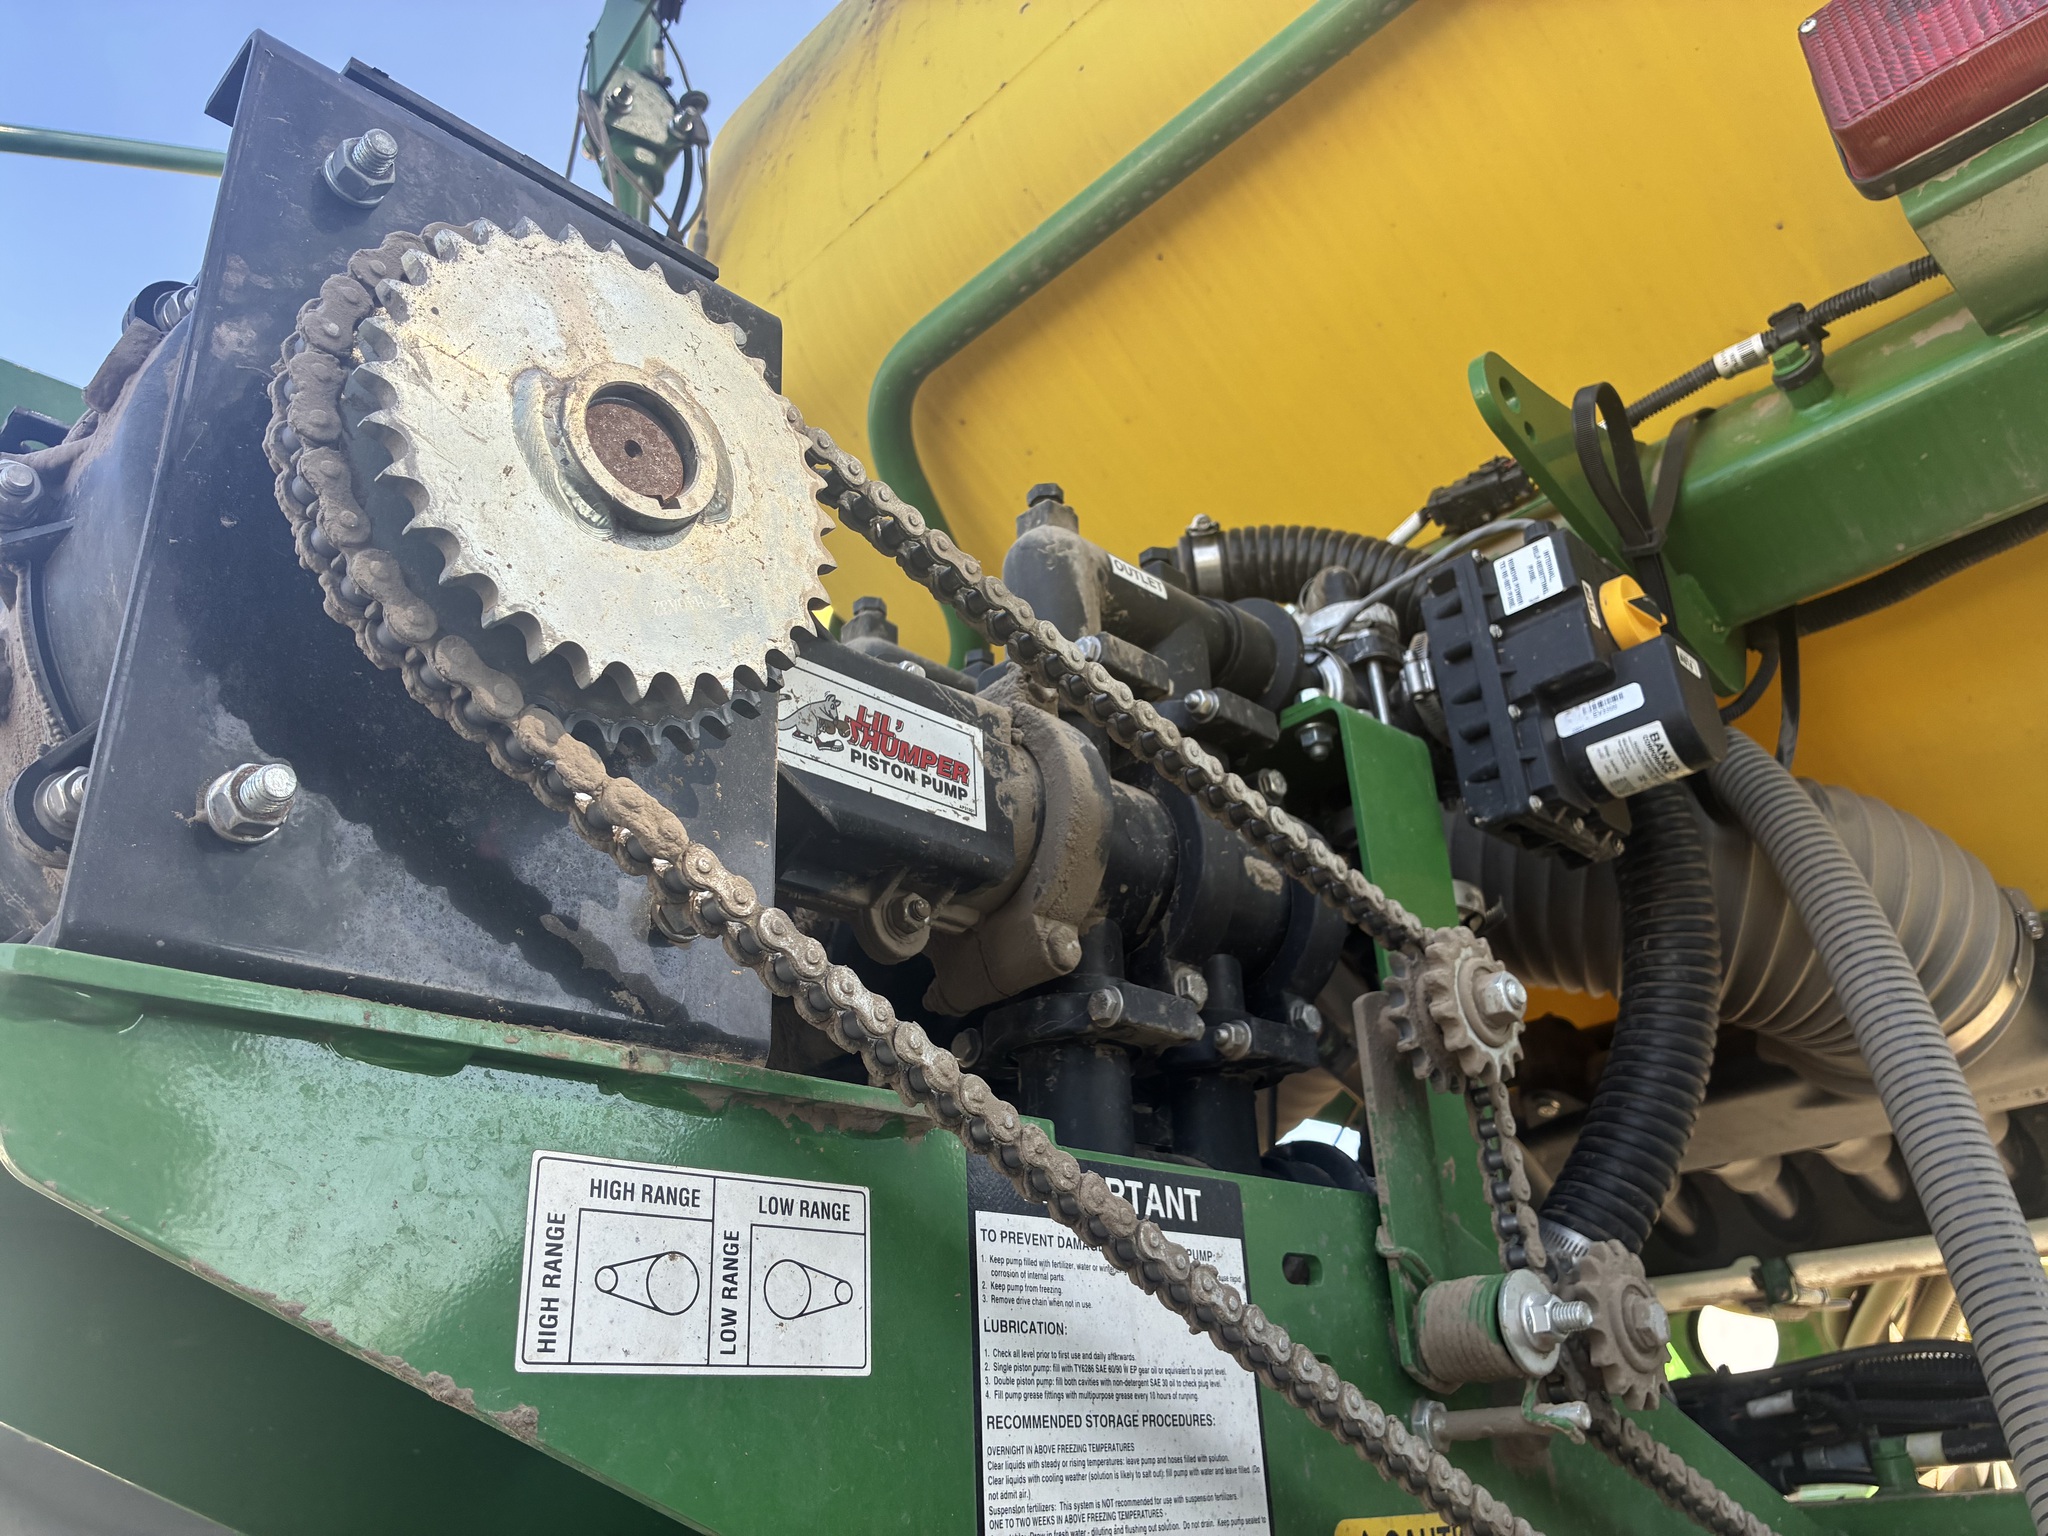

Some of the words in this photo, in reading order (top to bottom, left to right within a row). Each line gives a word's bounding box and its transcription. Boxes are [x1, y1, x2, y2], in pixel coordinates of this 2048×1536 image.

[1114, 559, 1162, 592] OUTLET
[857, 705, 904, 738] LIL'
[844, 715, 970, 787] THUMPER
[1650, 732, 1679, 772] BANJO
[851, 748, 915, 784] PISTON
[922, 774, 968, 800] PUMP
[590, 1178, 635, 1202] HIGH
[641, 1184, 701, 1208] RANGE
[759, 1196, 794, 1216] LOW
[799, 1200, 850, 1222] RANGE
[542, 1213, 566, 1288] RANGE
[980, 1229, 996, 1242] TO
[1000, 1231, 1054, 1247] PREVENT
[1187, 1249, 1216, 1261] PUMP:
[722, 1230, 739, 1300] RANGE
[990, 1255, 1005, 1266] Keep
[1006, 1257, 1022, 1267] pump
[1024, 1257, 1037, 1266] filled
[1039, 1259, 1051, 1268] with
[1077, 1263, 1091, 1271] water
[991, 1269, 1018, 1279] corrosion
[1020, 1270, 1026, 1279] of
[1028, 1270, 1048, 1280] internal
[1050, 1273, 1065, 1282] parts.
[982, 1281, 987, 1289] 2.
[990, 1282, 1006, 1292] Keep
[1007, 1284, 1023, 1293] pump
[1024, 1283, 1038, 1292] from
[1039, 1285, 1063, 1296] freezing.
[982, 1294, 988, 1303] 3.
[991, 1295, 1014, 1304] Remove
[1016, 1296, 1030, 1305] drive
[1032, 1297, 1048, 1306] chain
[1048, 1298, 1064, 1307] when
[1064, 1300, 1074, 1308] not
[537, 1297, 559, 1353] HIGH
[720, 1309, 738, 1355] LOW
[984, 1319, 1068, 1335] LUBRICATION:
[984, 1349, 990, 1358] 1.
[993, 1348, 1012, 1358] Check
[1021, 1349, 1035, 1358] level
[1037, 1350, 1050, 1360] prior
[1058, 1350, 1069, 1359] first
[1082, 1352, 1092, 1360] and
[1093, 1352, 1106, 1362] daily
[985, 1363, 990, 1371] 2.
[993, 1362, 1012, 1373] Single
[1013, 1364, 1032, 1373] piston
[1034, 1365, 1052, 1374] pump:
[1061, 1364, 1073, 1372] with
[1096, 1364, 1107, 1373] SAE
[1130, 1365, 1137, 1374] EP
[1138, 1367, 1150, 1376] gear
[1165, 1366, 1190, 1376] equivalent
[1204, 1367, 1214, 1376] port
[985, 1377, 990, 1385] 3.
[994, 1377, 1015, 1386] Double
[1016, 1377, 1035, 1387] piston
[1036, 1378, 1055, 1387] pump:
[1055, 1377, 1063, 1386] fill
[1064, 1377, 1077, 1386] both
[1078, 1377, 1099, 1386] cavities
[1100, 1378, 1112, 1386] with
[1113, 1378, 1149, 1388] non-detergent
[1150, 1378, 1161, 1387] SAE
[1162, 1378, 1168, 1387] 30
[1183, 1379, 1197, 1388] check
[1198, 1380, 1208, 1389] plug
[985, 1390, 991, 1399] 4.
[994, 1390, 1003, 1399] Fill
[1005, 1392, 1022, 1401] pump
[1023, 1392, 1043, 1401] grease
[1044, 1390, 1064, 1401] fittings
[1066, 1391, 1077, 1399] with
[1078, 1391, 1114, 1401] multipurpose
[1115, 1392, 1133, 1401] grease
[1134, 1393, 1148, 1401] every
[1157, 1391, 1172, 1400] hours
[987, 1415, 1082, 1430] RECOMMENDED
[1086, 1414, 1139, 1429] STORAGE
[1142, 1414, 1216, 1427] PROCEDURES:
[987, 1445, 1024, 1456] OVERNIGHT
[1026, 1445, 1033, 1454] IN
[1034, 1445, 1055, 1454] ABOVE
[1057, 1444, 1087, 1454] FREEZING
[1088, 1442, 1135, 1453] TEMPERATURES
[987, 1461, 1004, 1471] Clear
[1005, 1460, 1025, 1471] liquids
[1027, 1459, 1040, 1469] with
[1041, 1459, 1060, 1470] steady
[1069, 1458, 1086, 1469] rising
[1087, 1457, 1124, 1468] temperatures:
[1125, 1456, 1140, 1465] leave
[1141, 1457, 1155, 1466] pump
[1157, 1456, 1167, 1464] and
[1168, 1455, 1183, 1463] hoses
[1184, 1455, 1196, 1463] filled
[1208, 1454, 1229, 1463] solution.
[988, 1476, 1004, 1485] Clear
[1005, 1475, 1026, 1486] liquids
[1028, 1474, 1040, 1483] with
[1042, 1473, 1064, 1484] cooling
[1065, 1472, 1087, 1481] weather
[1089, 1471, 1113, 1482] (solution
[1120, 1470, 1134, 1480] likely
[1142, 1470, 1151, 1478] salt
[1174, 1469, 1188, 1478] pump
[1189, 1468, 1199, 1476] with
[1215, 1467, 1224, 1475] and
[1225, 1466, 1238, 1474] leave
[988, 1491, 999, 1500] not
[1000, 1490, 1018, 1499] admit
[1019, 1489, 1031, 1500] air.)
[989, 1505, 1026, 1517] Suspension
[1027, 1504, 1057, 1513] fertilizers:
[1060, 1502, 1072, 1510] This
[1074, 1501, 1094, 1512] system
[1102, 1499, 1113, 1508] NOT
[1115, 1497, 1154, 1507] recommended
[1154, 1496, 1162, 1505] for
[1174, 1495, 1184, 1503] with
[1185, 1494, 1214, 1504] suspension
[989, 1519, 1003, 1530] ONE
[1005, 1518, 1014, 1529] TO
[1016, 1517, 1031, 1528] TWO
[1032, 1515, 1055, 1526] WEEKS
[1056, 1515, 1063, 1525] IN
[1064, 1513, 1086, 1524] ABOVE
[1087, 1511, 1116, 1522] FREEZING
[1117, 1508, 1164, 1520] TEMPERATURES
